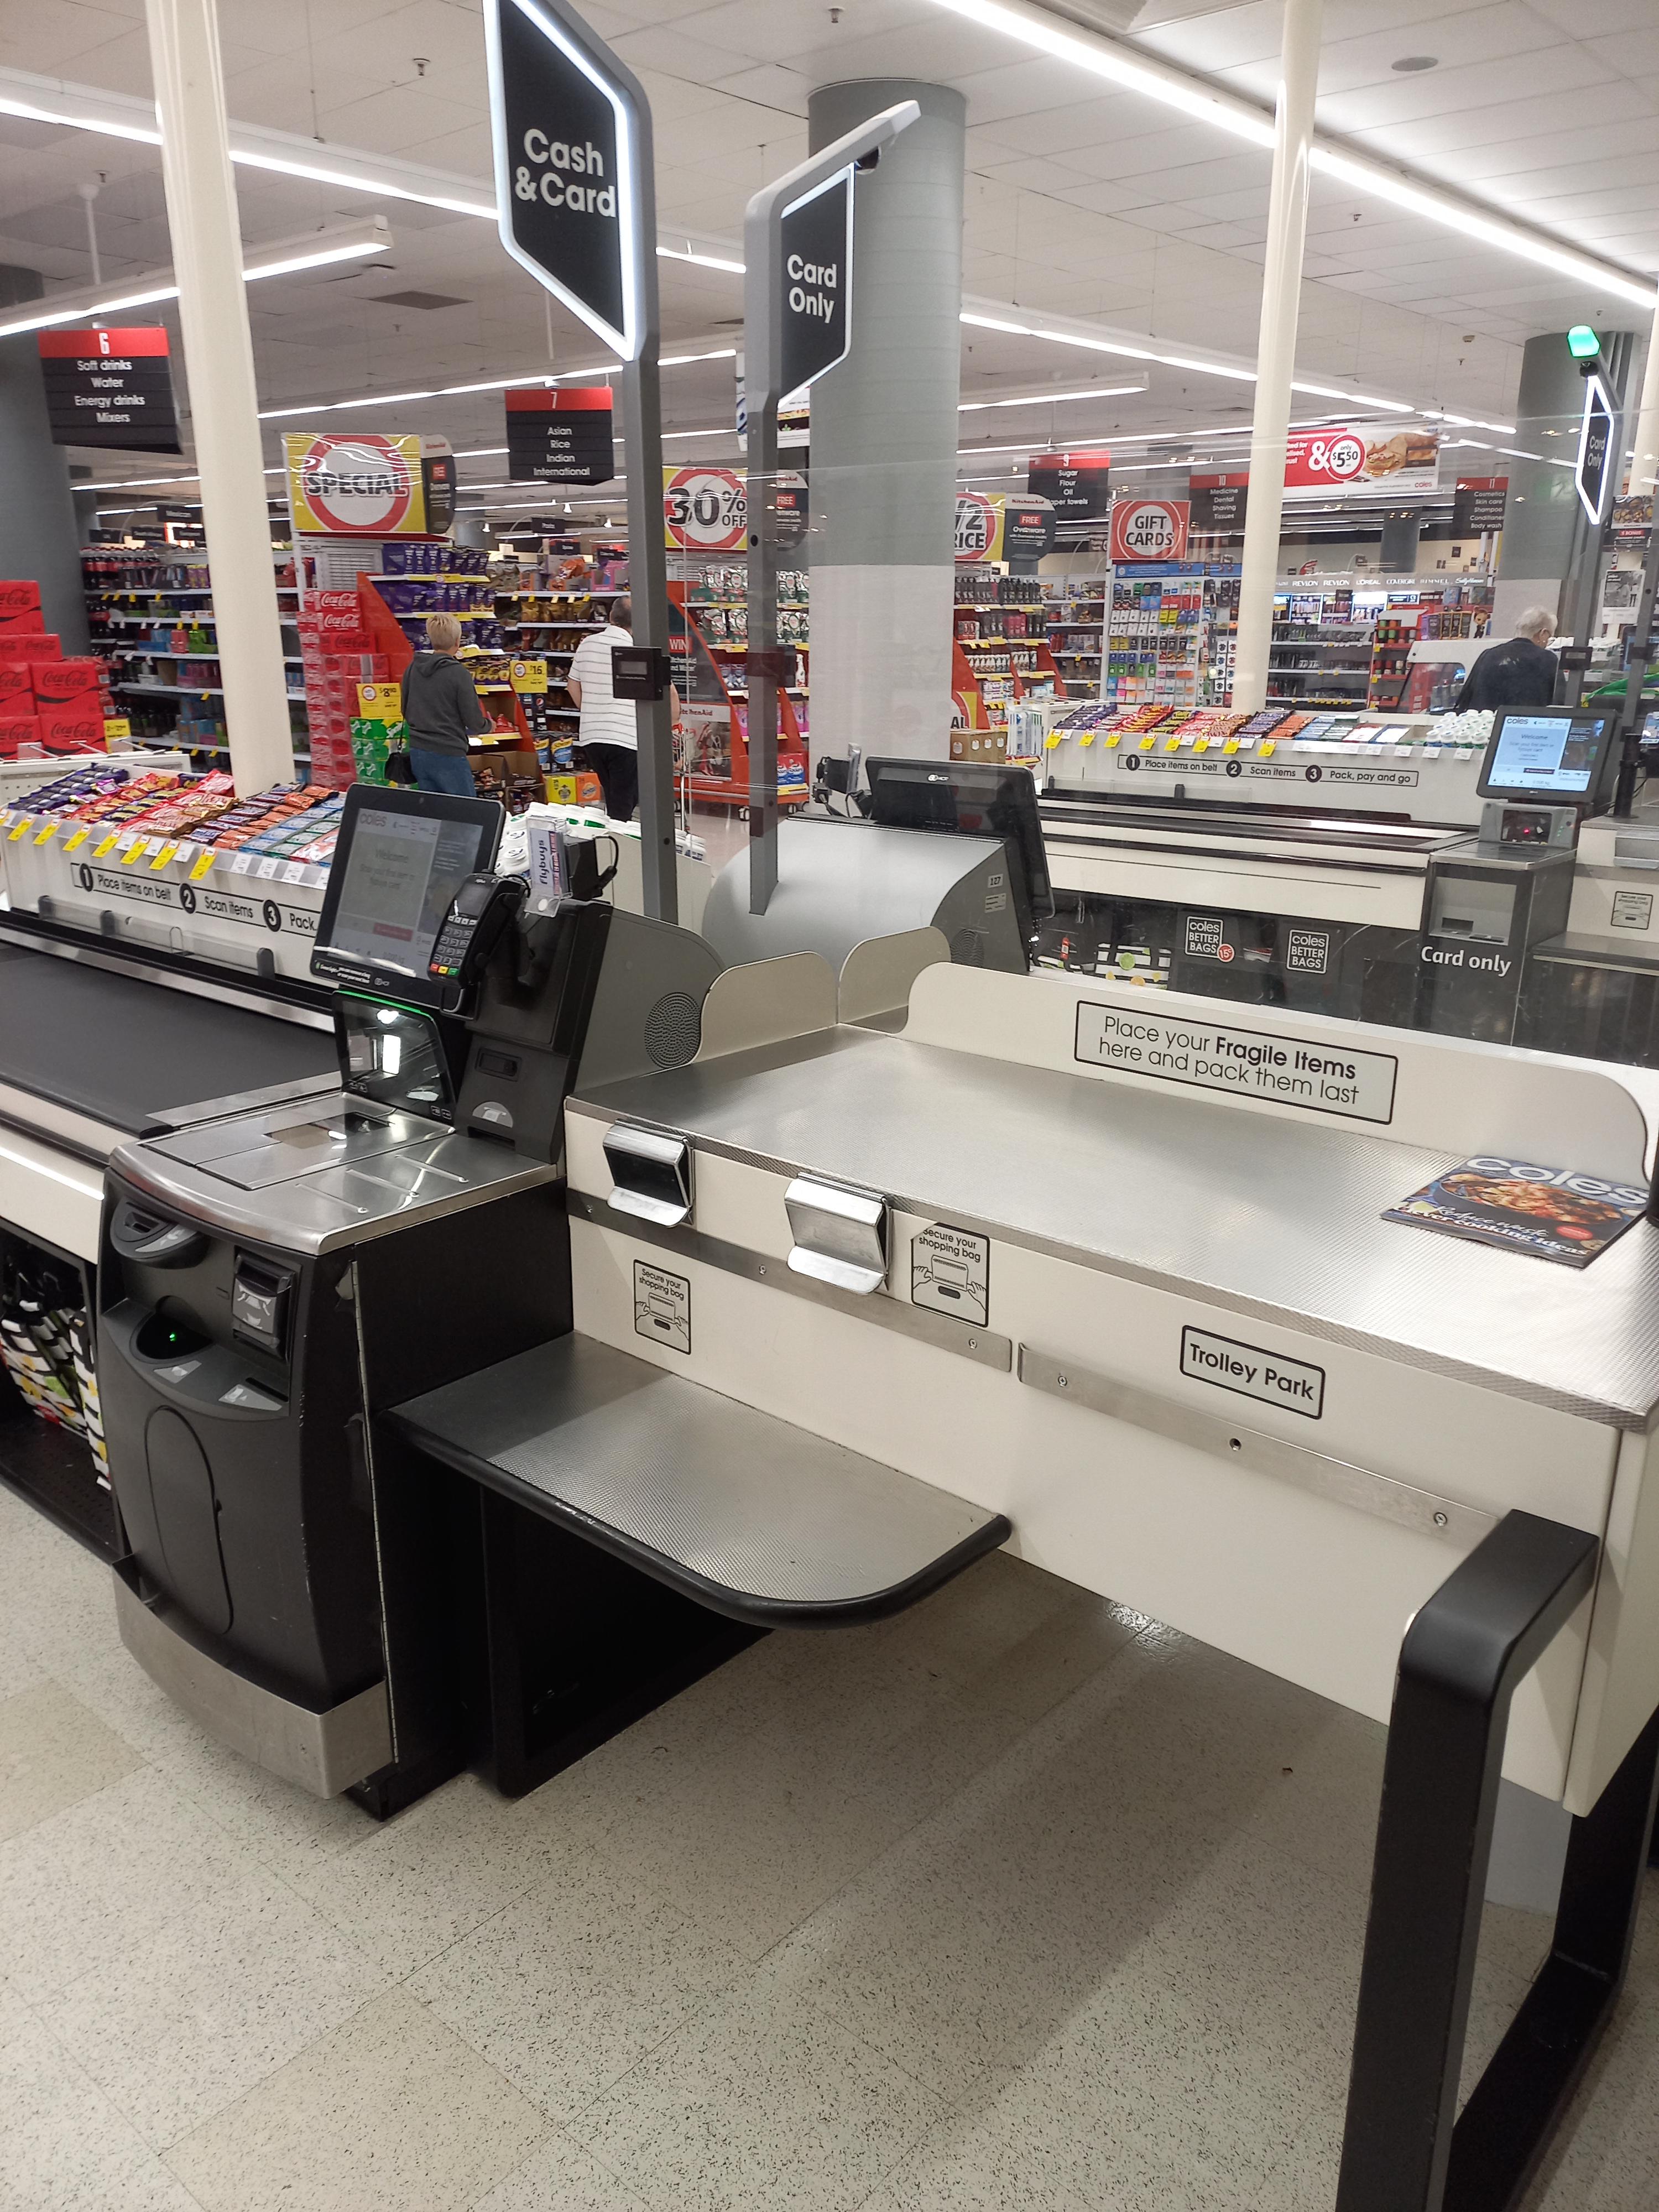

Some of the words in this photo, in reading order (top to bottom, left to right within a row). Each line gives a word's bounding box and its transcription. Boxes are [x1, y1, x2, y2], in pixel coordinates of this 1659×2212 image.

[523, 128, 604, 178] Cash
[514, 166, 538, 202] &
[540, 172, 617, 218] Card
[786, 253, 837, 289] Card
[788, 286, 836, 324] Only
[98, 332, 111, 355] 6
[76, 359, 98, 371] Soft
[100, 359, 133, 371] drinks
[90, 377, 124, 388] Water
[74, 395, 112, 408] Energy
[113, 394, 146, 405] drinks
[550, 391, 558, 409] 7
[96, 412, 131, 422] Mixers
[546, 426, 573, 435] Asian
[550, 439, 571, 448] Rice
[1589, 435, 1606, 450] Card
[546, 453, 576, 462] Indian
[1063, 453, 1070, 467] 9
[1308, 440, 1331, 471] &
[1587, 453, 1603, 469] Only
[533, 466, 591, 476] International
[1058, 469, 1079, 478] Sugar
[306, 471, 409, 497] SPECIAL
[1218, 474, 1227, 487] 10
[1489, 478, 1496, 489] 11
[667, 487, 747, 526] 30%
[722, 514, 747, 528] OFF
[1021, 515, 1040, 524] FREE
[1135, 515, 1167, 530] GIFT
[1125, 532, 1175, 546] CARDS
[669, 638, 687, 650] WIN
[1145, 759, 1166, 768] Place
[1168, 760, 1189, 770] items
[1202, 763, 1218, 771] belt
[1229, 763, 1238, 775] 2
[1250, 766, 1271, 775] Scan
[1273, 768, 1296, 777] items
[1310, 768, 1318, 779] 3
[1330, 770, 1355, 781] Pack,
[1357, 772, 1375, 781] pay
[1377, 771, 1396, 781] and
[1398, 775, 1411, 784] go
[360, 811, 387, 827] coles
[97, 874, 120, 890] Place
[121, 879, 142, 894] items
[143, 885, 154, 896] on
[155, 885, 171, 900] belt
[183, 889, 194, 909] 2
[204, 896, 227, 912] Scan
[228, 901, 254, 918] items
[267, 904, 276, 928] 3
[1190, 921, 1220, 933] coles
[1188, 932, 1220, 945] BETTER
[1292, 935, 1326, 947] coles
[1190, 942, 1217, 953] BAGS
[1291, 946, 1324, 959] BETTER
[1292, 956, 1322, 969] BAGS
[1421, 946, 1465, 967] Card
[1468, 954, 1512, 977] only
[1104, 1015, 1159, 1042] Place
[1165, 1030, 1211, 1052] your
[1215, 1036, 1287, 1067] Fragile
[1294, 1050, 1357, 1079] Items
[1099, 1037, 1142, 1061] here
[1148, 1050, 1189, 1072] and
[1195, 1058, 1249, 1083] pack
[1255, 1068, 1313, 1096] them
[1320, 1079, 1360, 1104] last
[1466, 1157, 1651, 1206] coles
[1437, 1204, 1494, 1224] Reduce
[1496, 1219, 1550, 1238] waste
[922, 1228, 954, 1243] Secure
[956, 1237, 977, 1249] your
[1458, 1219, 1533, 1242] cooking
[1535, 1237, 1589, 1256] ideas
[919, 1236, 960, 1257] shopping
[962, 1248, 981, 1263] bag
[641, 1268, 665, 1284] Secure
[665, 1279, 681, 1290] your
[639, 1276, 669, 1295] shopping
[670, 1287, 684, 1301] bag
[1190, 1342, 1258, 1384] Trolley
[1264, 1366, 1314, 1401] Park
